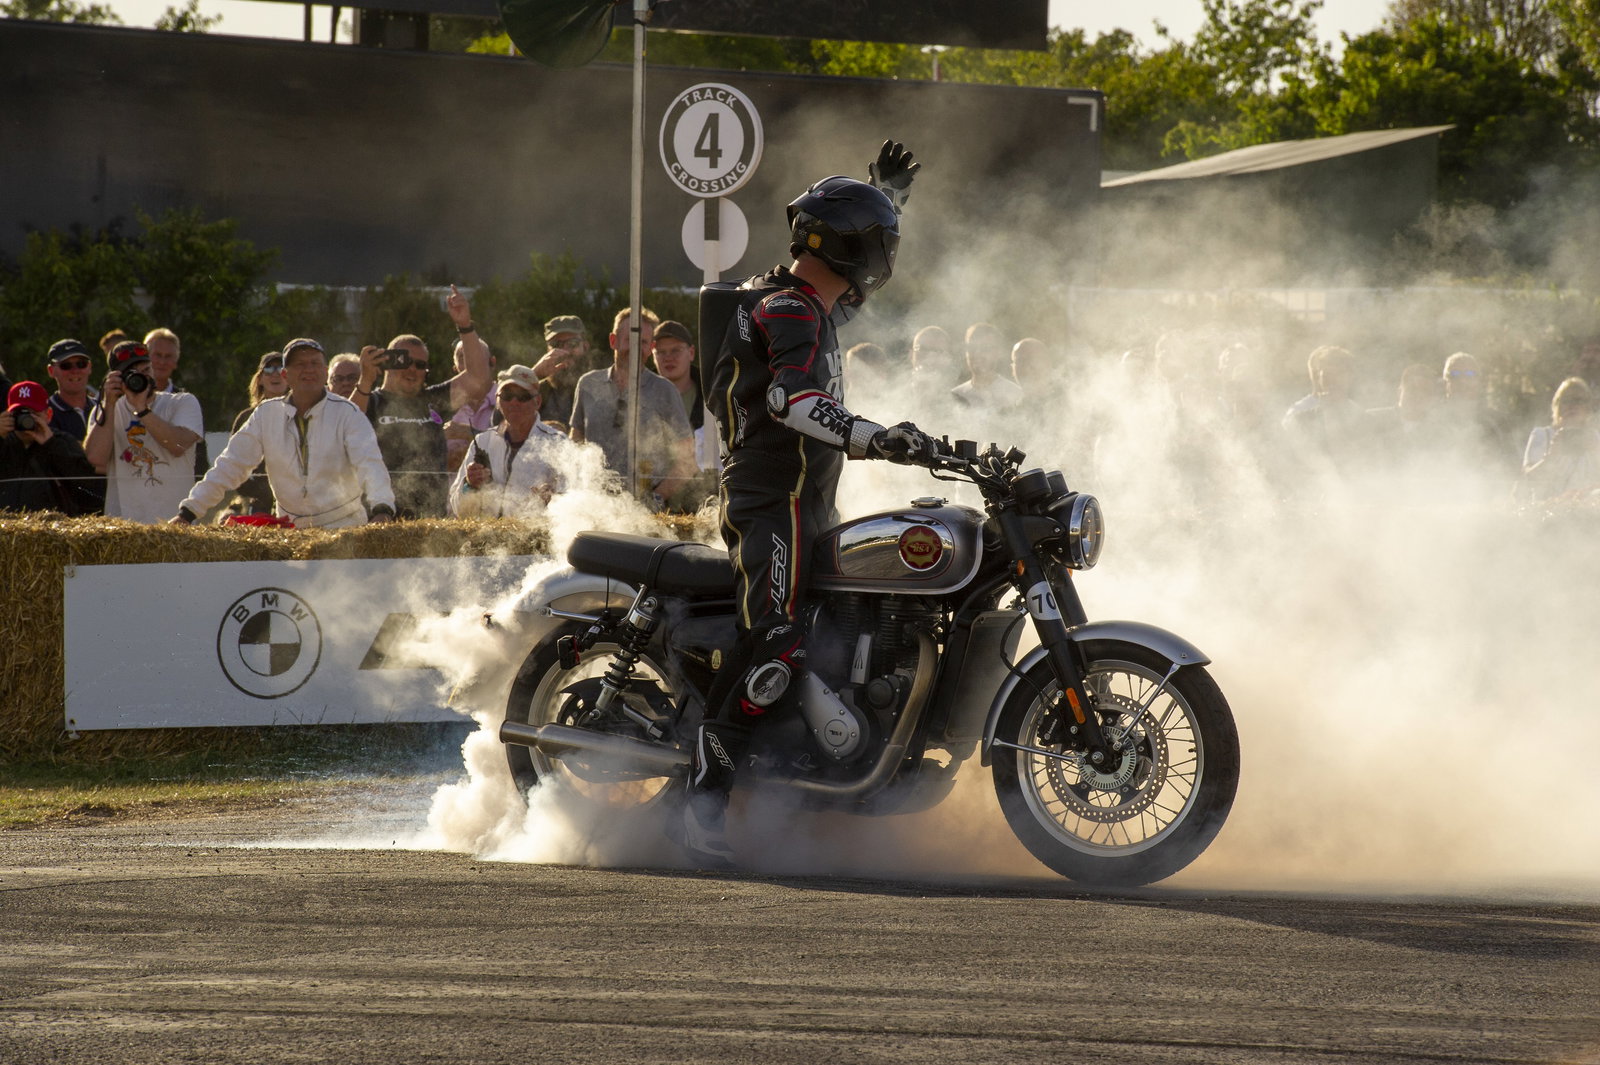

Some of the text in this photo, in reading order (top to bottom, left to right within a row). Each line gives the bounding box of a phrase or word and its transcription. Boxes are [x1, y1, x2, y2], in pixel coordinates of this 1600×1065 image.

[681, 88, 739, 109] TRACK
[693, 112, 722, 169] 4
[670, 161, 747, 192] CROSSING
[770, 532, 788, 615] RST
[231, 592, 309, 624] BMW
[1031, 591, 1056, 614] 70
[705, 731, 736, 772] RST
